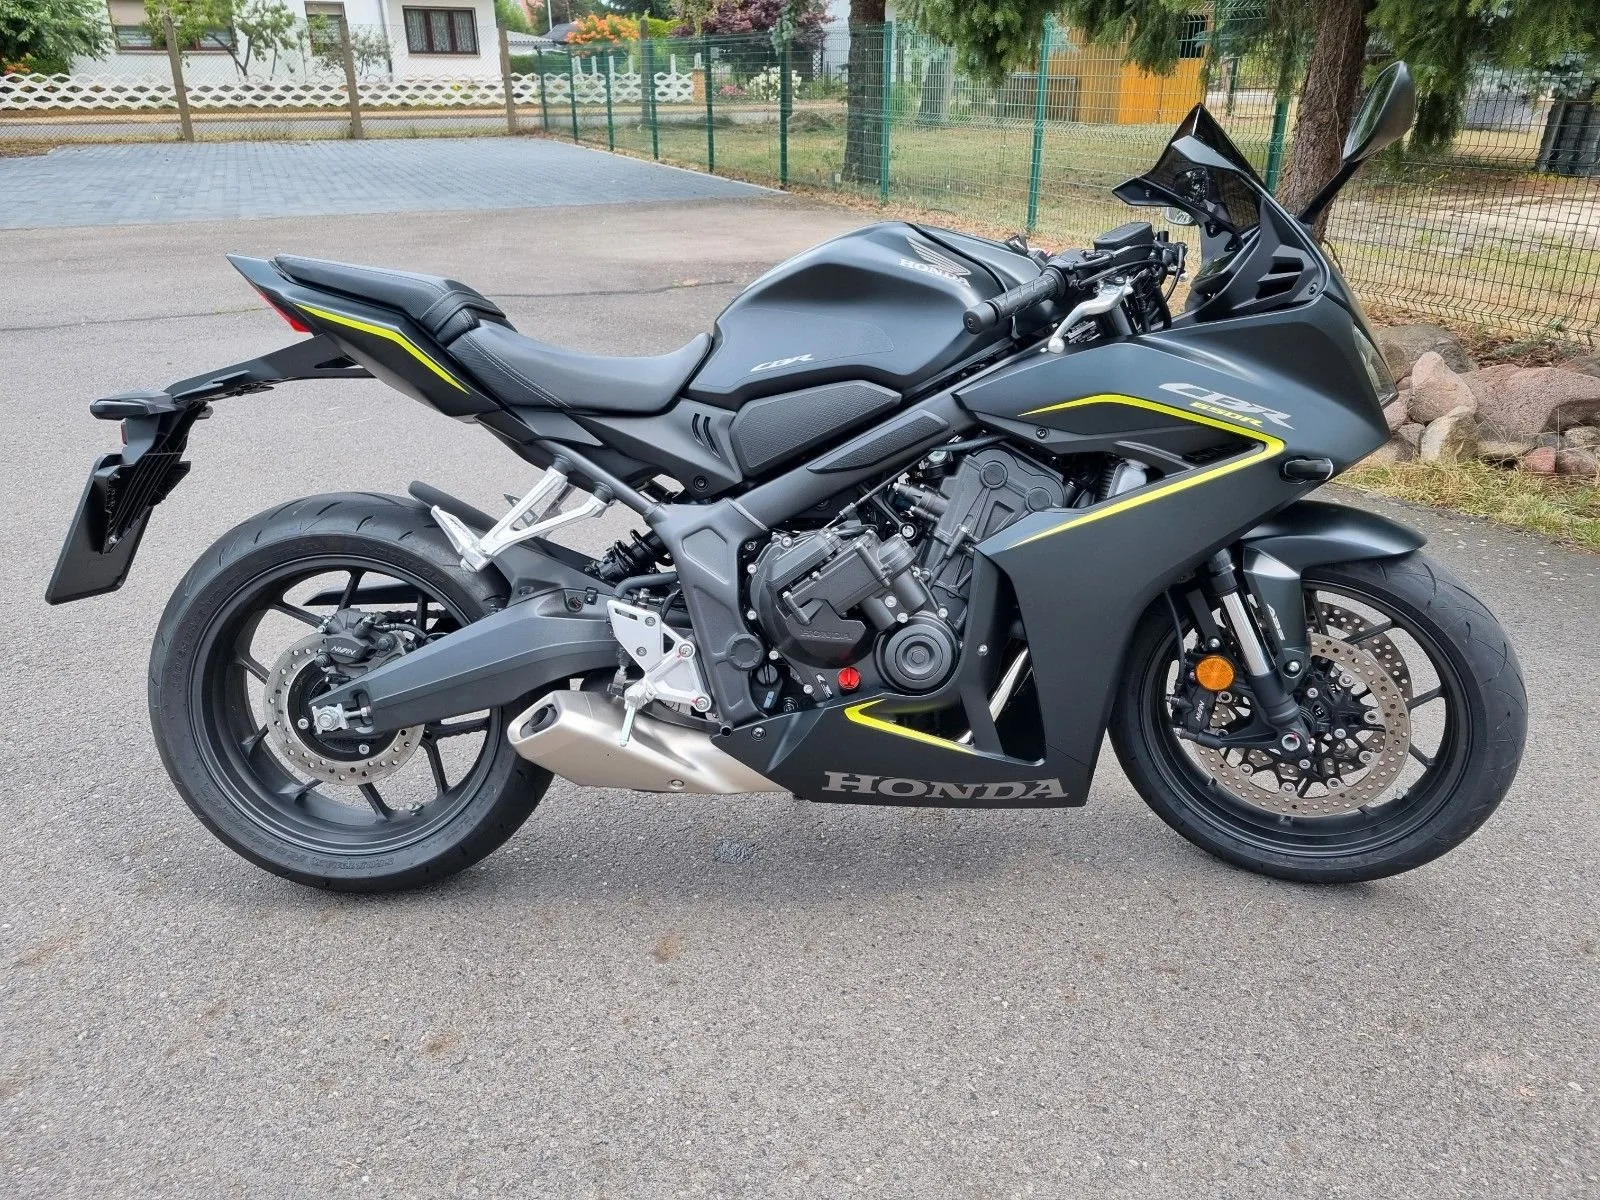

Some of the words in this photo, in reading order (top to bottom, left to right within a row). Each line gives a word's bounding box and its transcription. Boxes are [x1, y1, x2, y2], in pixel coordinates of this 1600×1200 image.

[899, 258, 972, 289] HONDA
[750, 353, 815, 373] CBR
[1158, 382, 1296, 431] CBR
[1189, 401, 1263, 428] 650R
[821, 770, 1069, 800] HONDA
